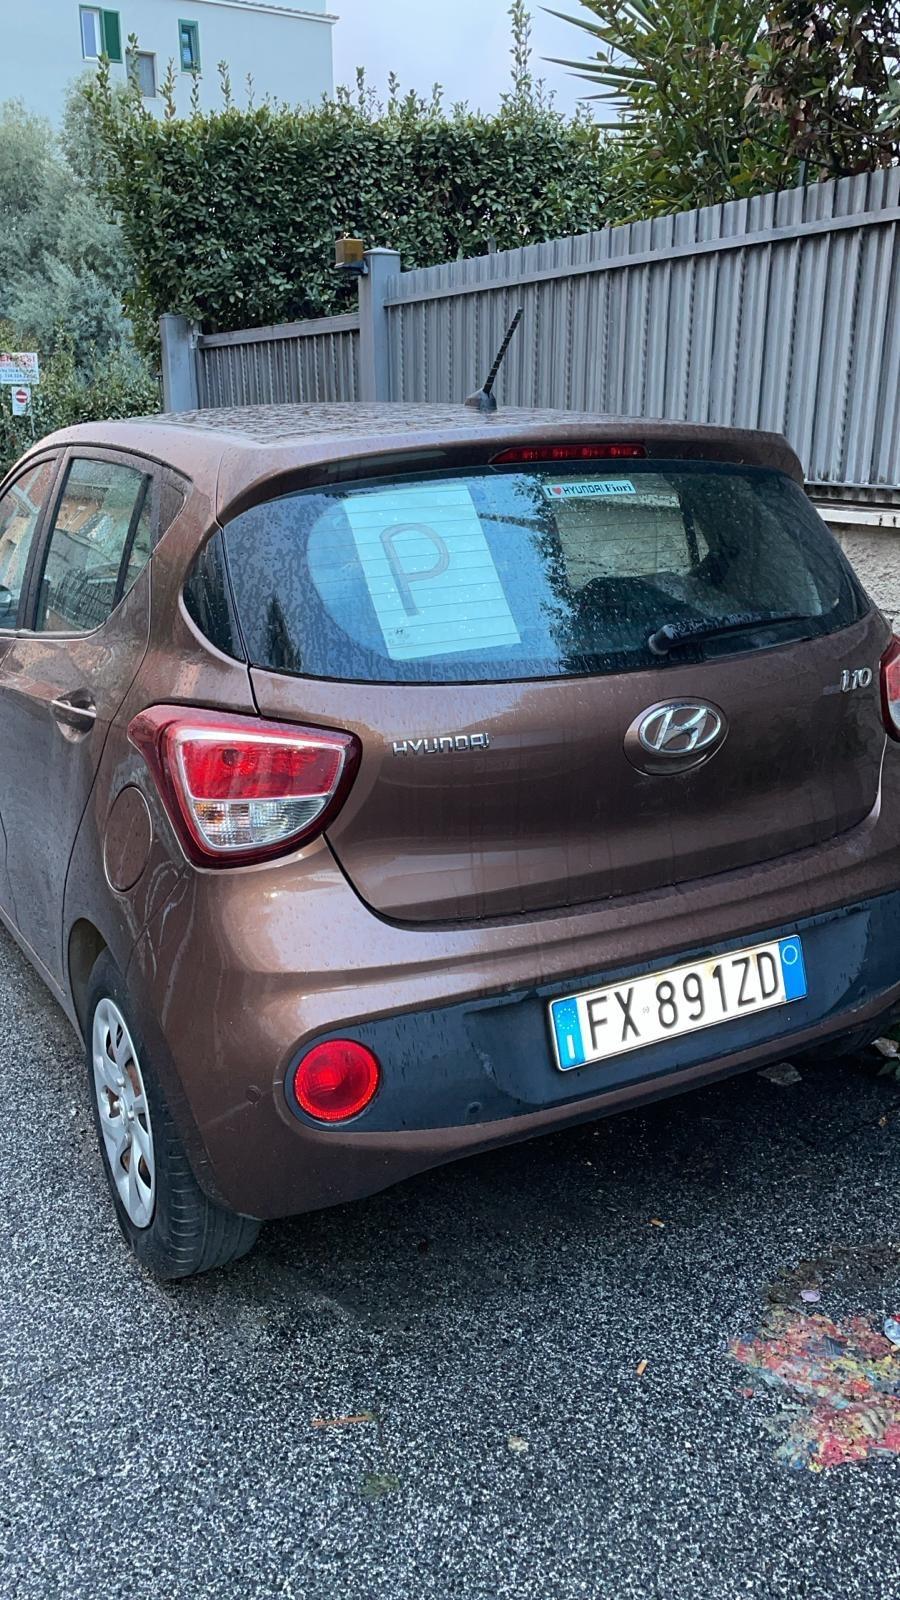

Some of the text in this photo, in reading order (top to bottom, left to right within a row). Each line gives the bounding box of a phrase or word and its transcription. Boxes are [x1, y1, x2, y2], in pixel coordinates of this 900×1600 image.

[563, 485, 605, 494] HYUNDAI
[605, 483, 633, 493] Fiori
[379, 522, 450, 617] P
[841, 667, 873, 692] i10
[392, 732, 491, 755] HYUNDAI
[585, 987, 641, 1050] FX
[655, 951, 780, 1029] 891ZD
